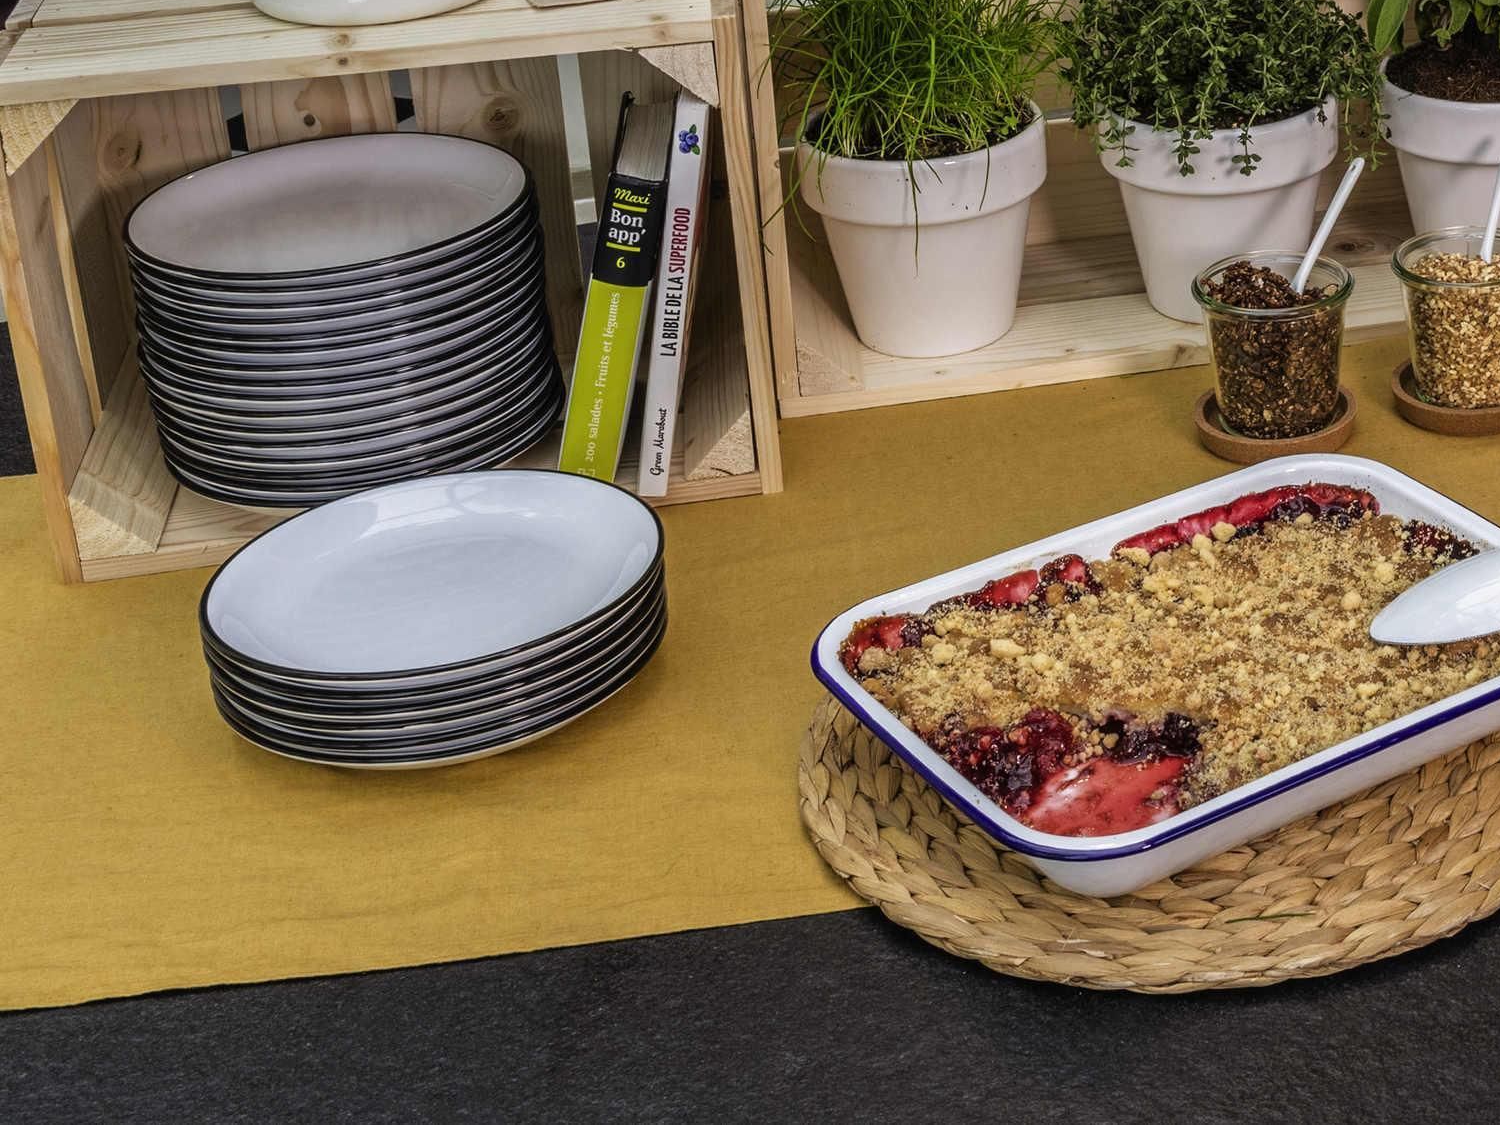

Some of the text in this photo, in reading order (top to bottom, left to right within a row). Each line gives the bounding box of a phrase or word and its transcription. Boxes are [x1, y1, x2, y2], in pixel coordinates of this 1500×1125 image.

[614, 186, 652, 206] Maxi
[610, 208, 644, 229] Bon
[615, 256, 626, 269] 6
[661, 207, 691, 357] LA BIBLE DE LA SUPERFOOD
[603, 292, 620, 338] légumes
[603, 340, 612, 352] et
[595, 353, 610, 389] Fruits
[588, 398, 603, 439] salades
[585, 442, 596, 462] 200
[650, 408, 667, 476] Green Marabout
